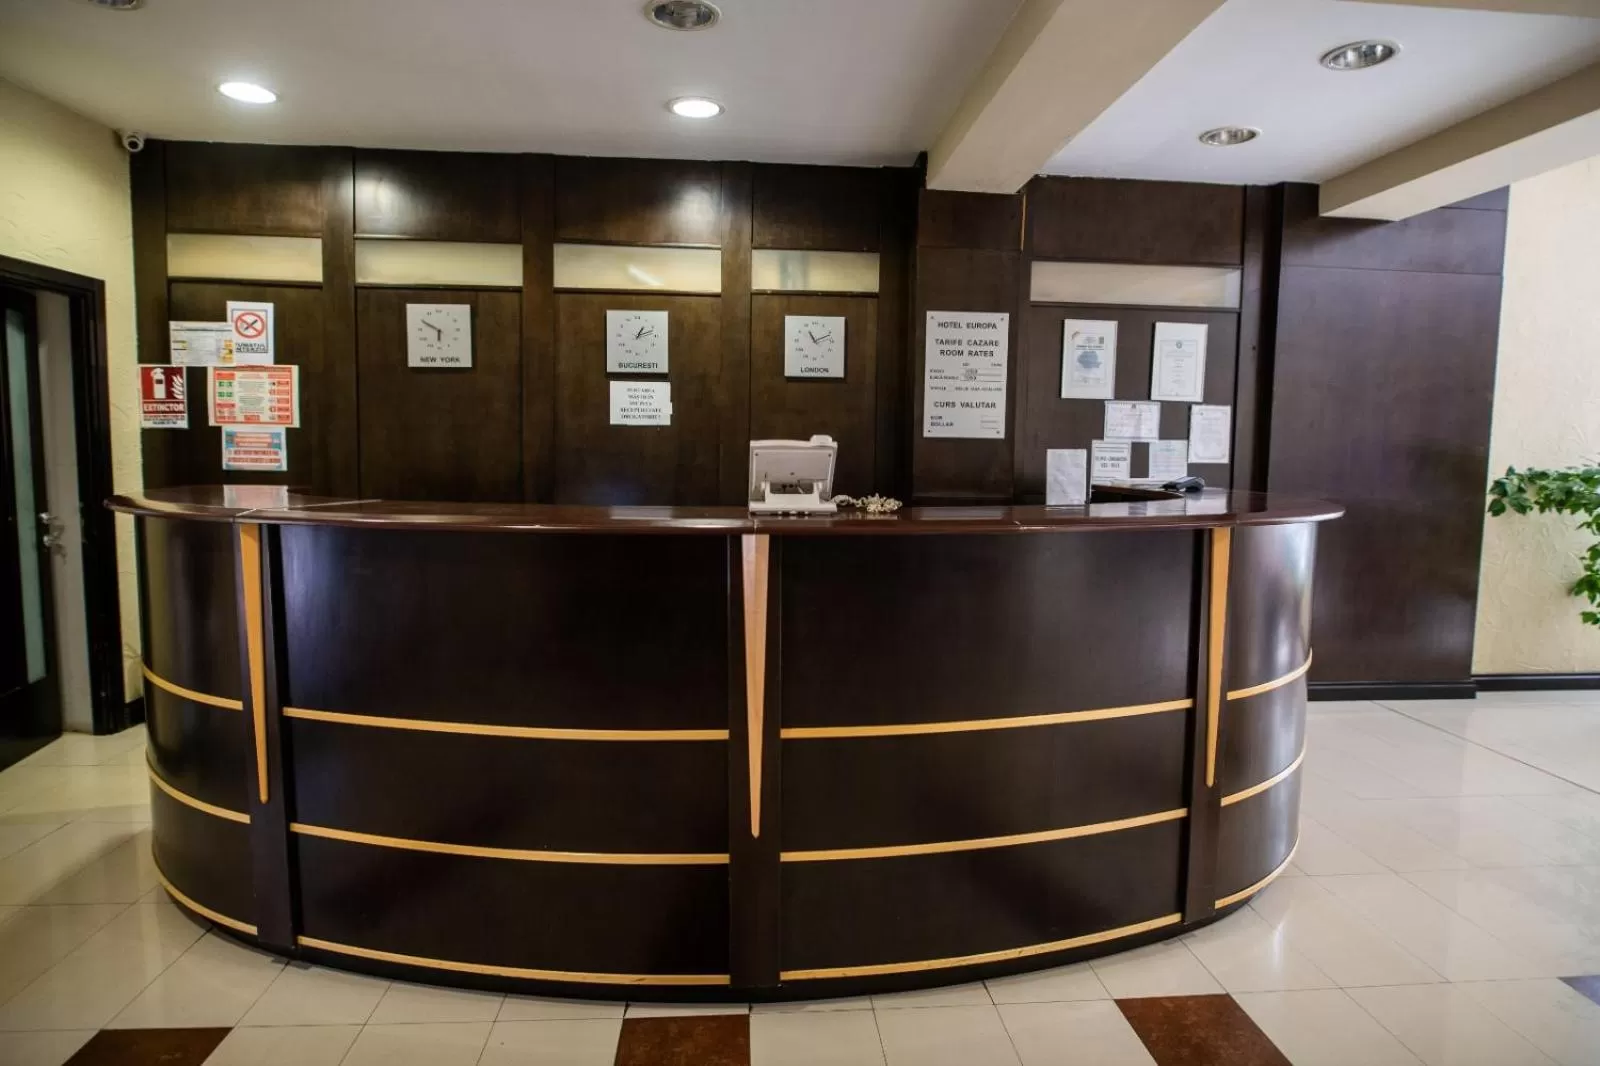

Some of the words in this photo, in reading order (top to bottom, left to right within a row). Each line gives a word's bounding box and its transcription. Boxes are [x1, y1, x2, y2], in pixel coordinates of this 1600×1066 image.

[937, 321, 962, 329] HOTEL
[966, 322, 997, 330] EUROPA
[935, 338, 963, 346] TARIFE
[967, 339, 999, 347] CAZARE
[940, 349, 964, 357] ROOM
[968, 350, 994, 358] RATES
[144, 403, 185, 411] EXTINCTOR
[934, 401, 957, 409] CURS
[960, 401, 997, 409] VALUTAR
